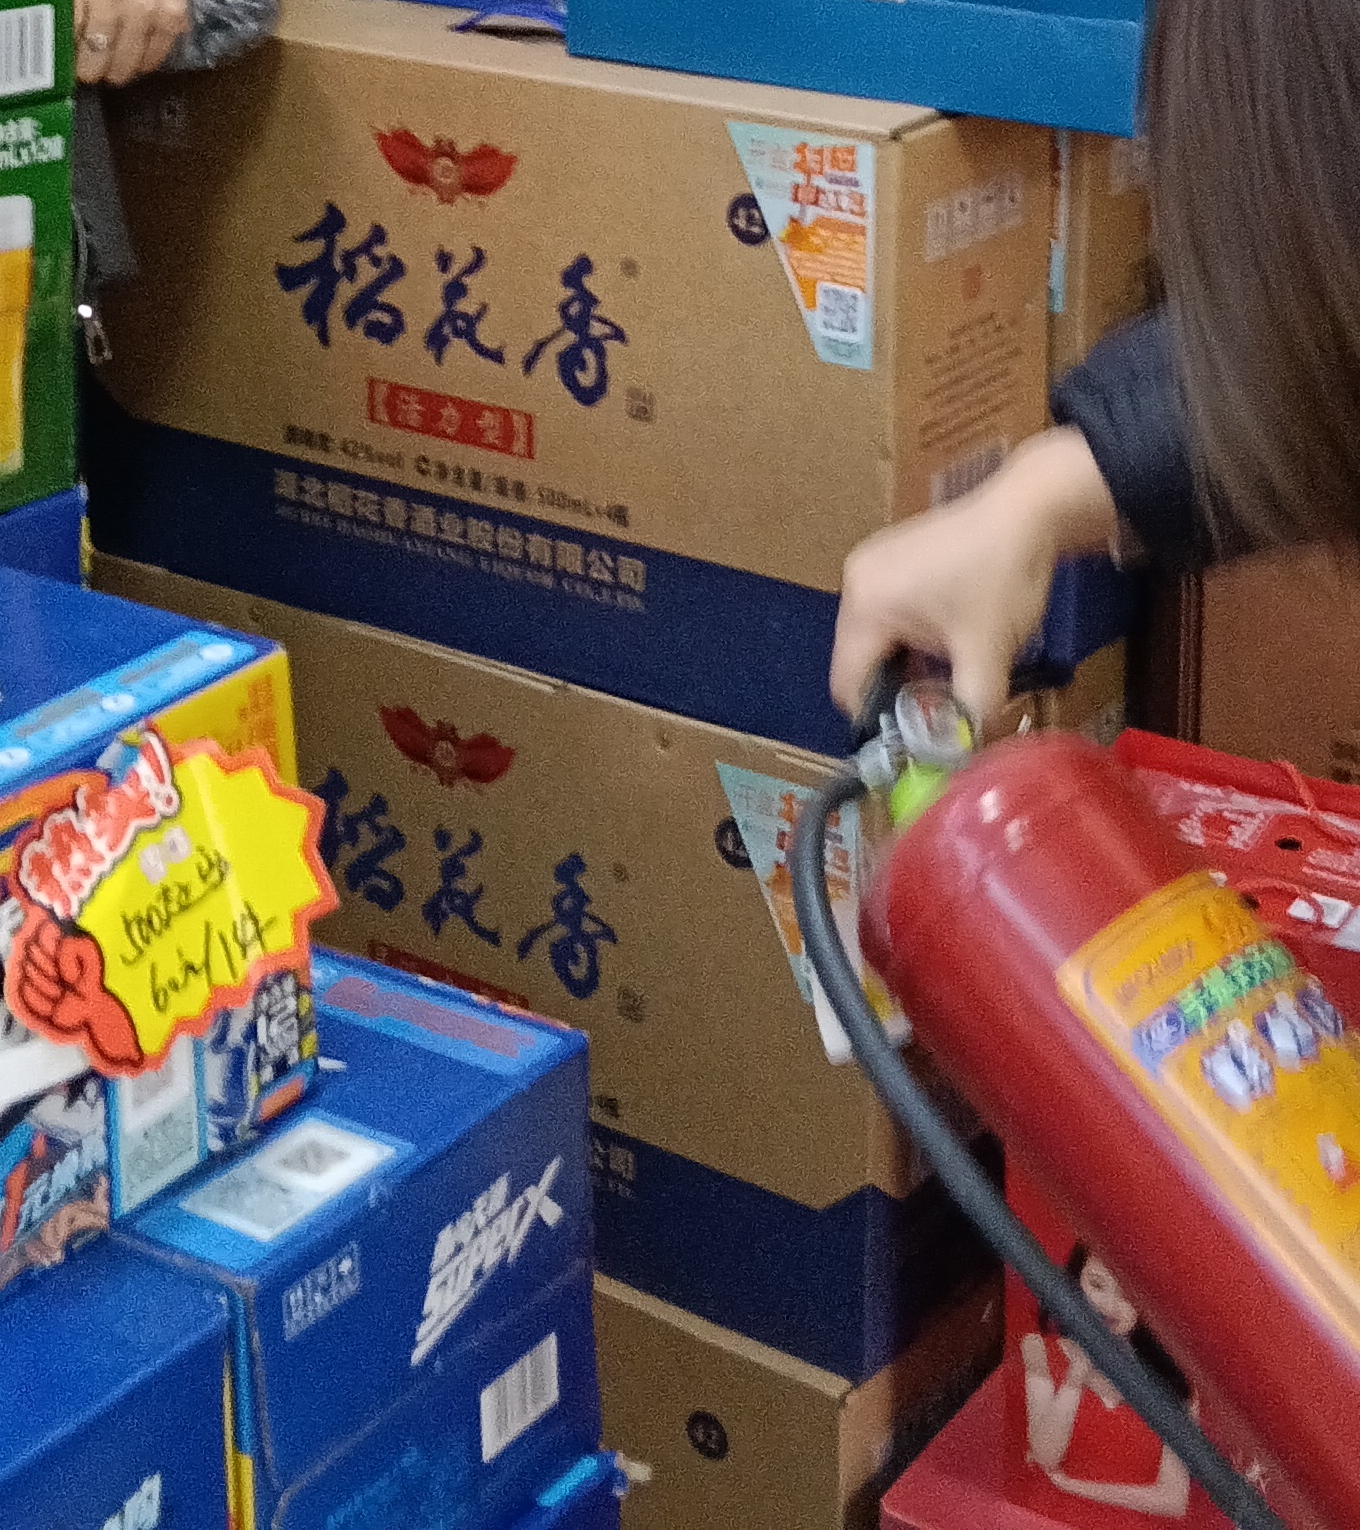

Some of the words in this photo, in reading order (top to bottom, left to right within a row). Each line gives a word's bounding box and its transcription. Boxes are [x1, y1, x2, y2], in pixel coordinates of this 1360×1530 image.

[273, 200, 628, 408] 稻花香
[321, 768, 619, 1000] 稻花香
